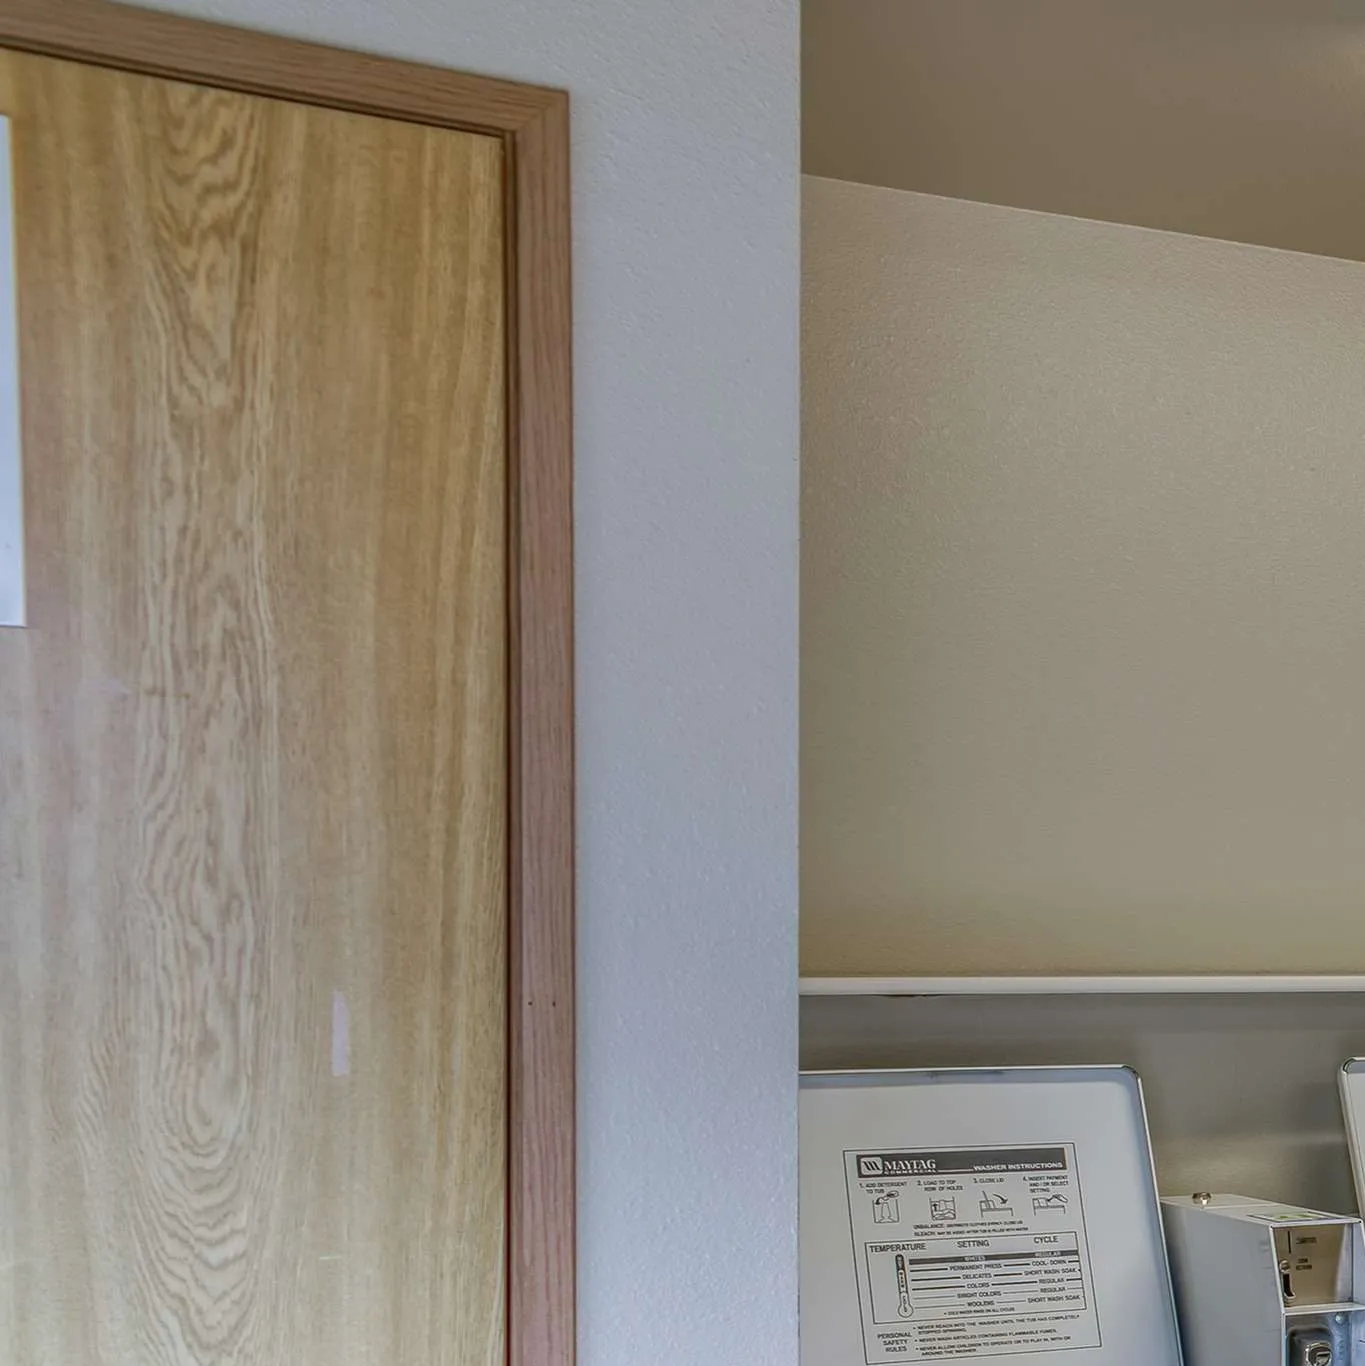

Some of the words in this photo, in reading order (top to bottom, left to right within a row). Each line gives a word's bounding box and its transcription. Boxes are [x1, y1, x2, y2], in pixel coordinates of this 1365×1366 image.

[884, 1159, 936, 1170] MAYTAG
[1008, 1162, 1062, 1170] INSTRUCTIONS
[869, 1243, 926, 1252] TEMPERATURE
[956, 1240, 990, 1248] SETTING
[1034, 1236, 1058, 1244] CYCLE
[962, 1272, 992, 1280] DELICATES
[978, 1290, 1002, 1298] COLORS
